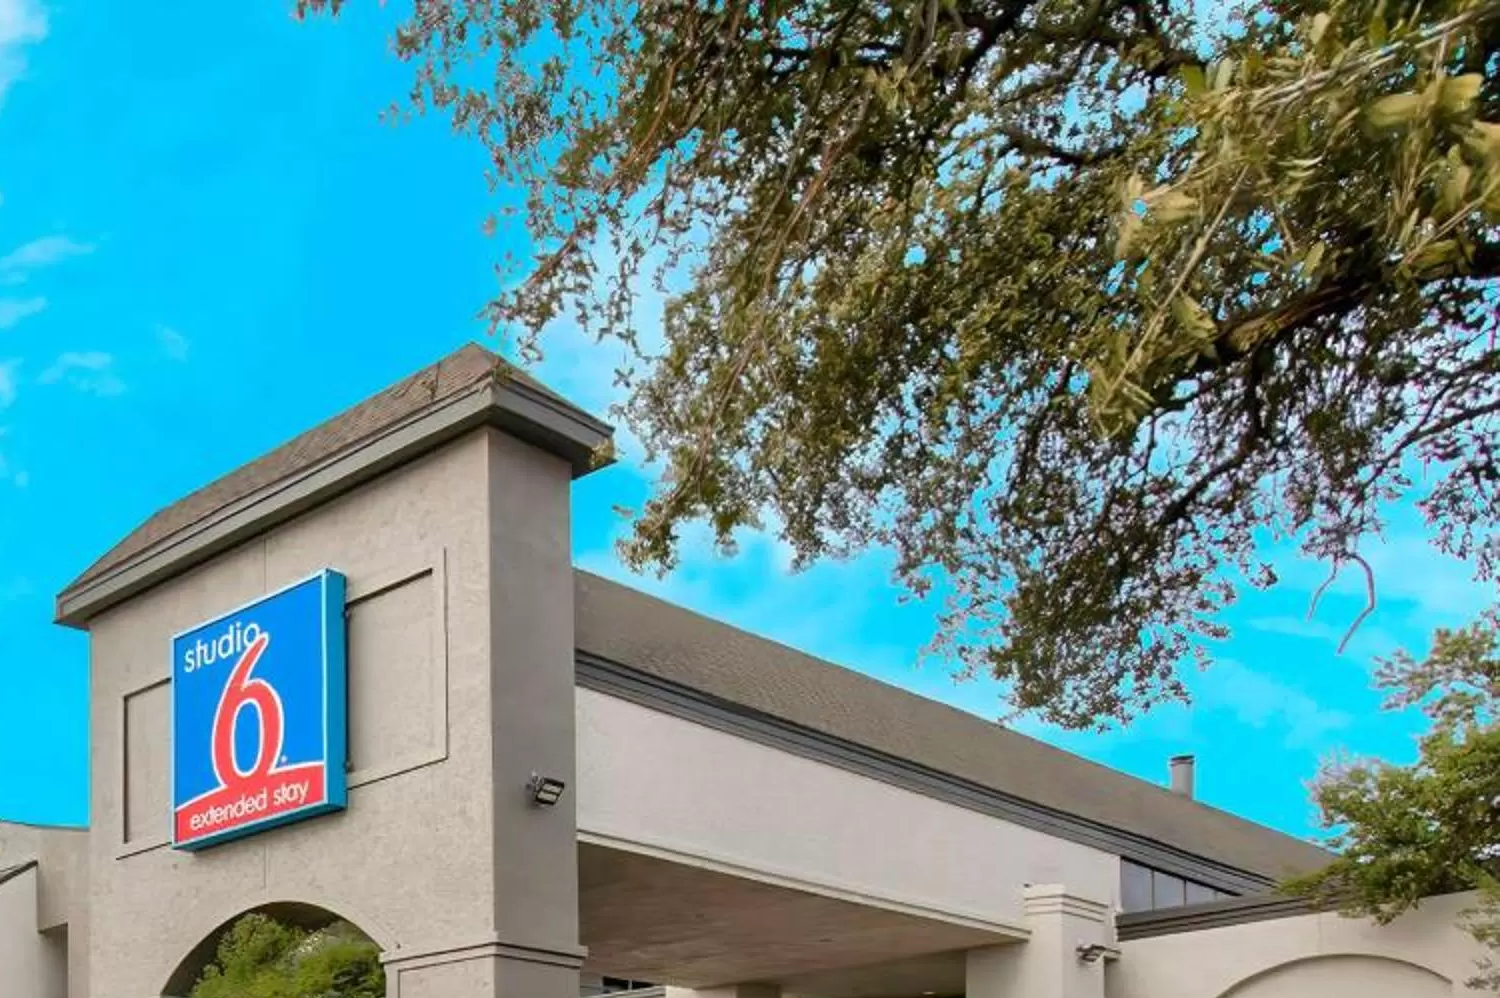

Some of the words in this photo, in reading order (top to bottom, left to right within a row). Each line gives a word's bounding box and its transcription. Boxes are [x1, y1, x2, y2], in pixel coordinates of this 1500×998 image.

[184, 622, 261, 673] studio
[211, 632, 284, 788] 6
[189, 789, 268, 831] extended
[273, 781, 310, 807] stay
